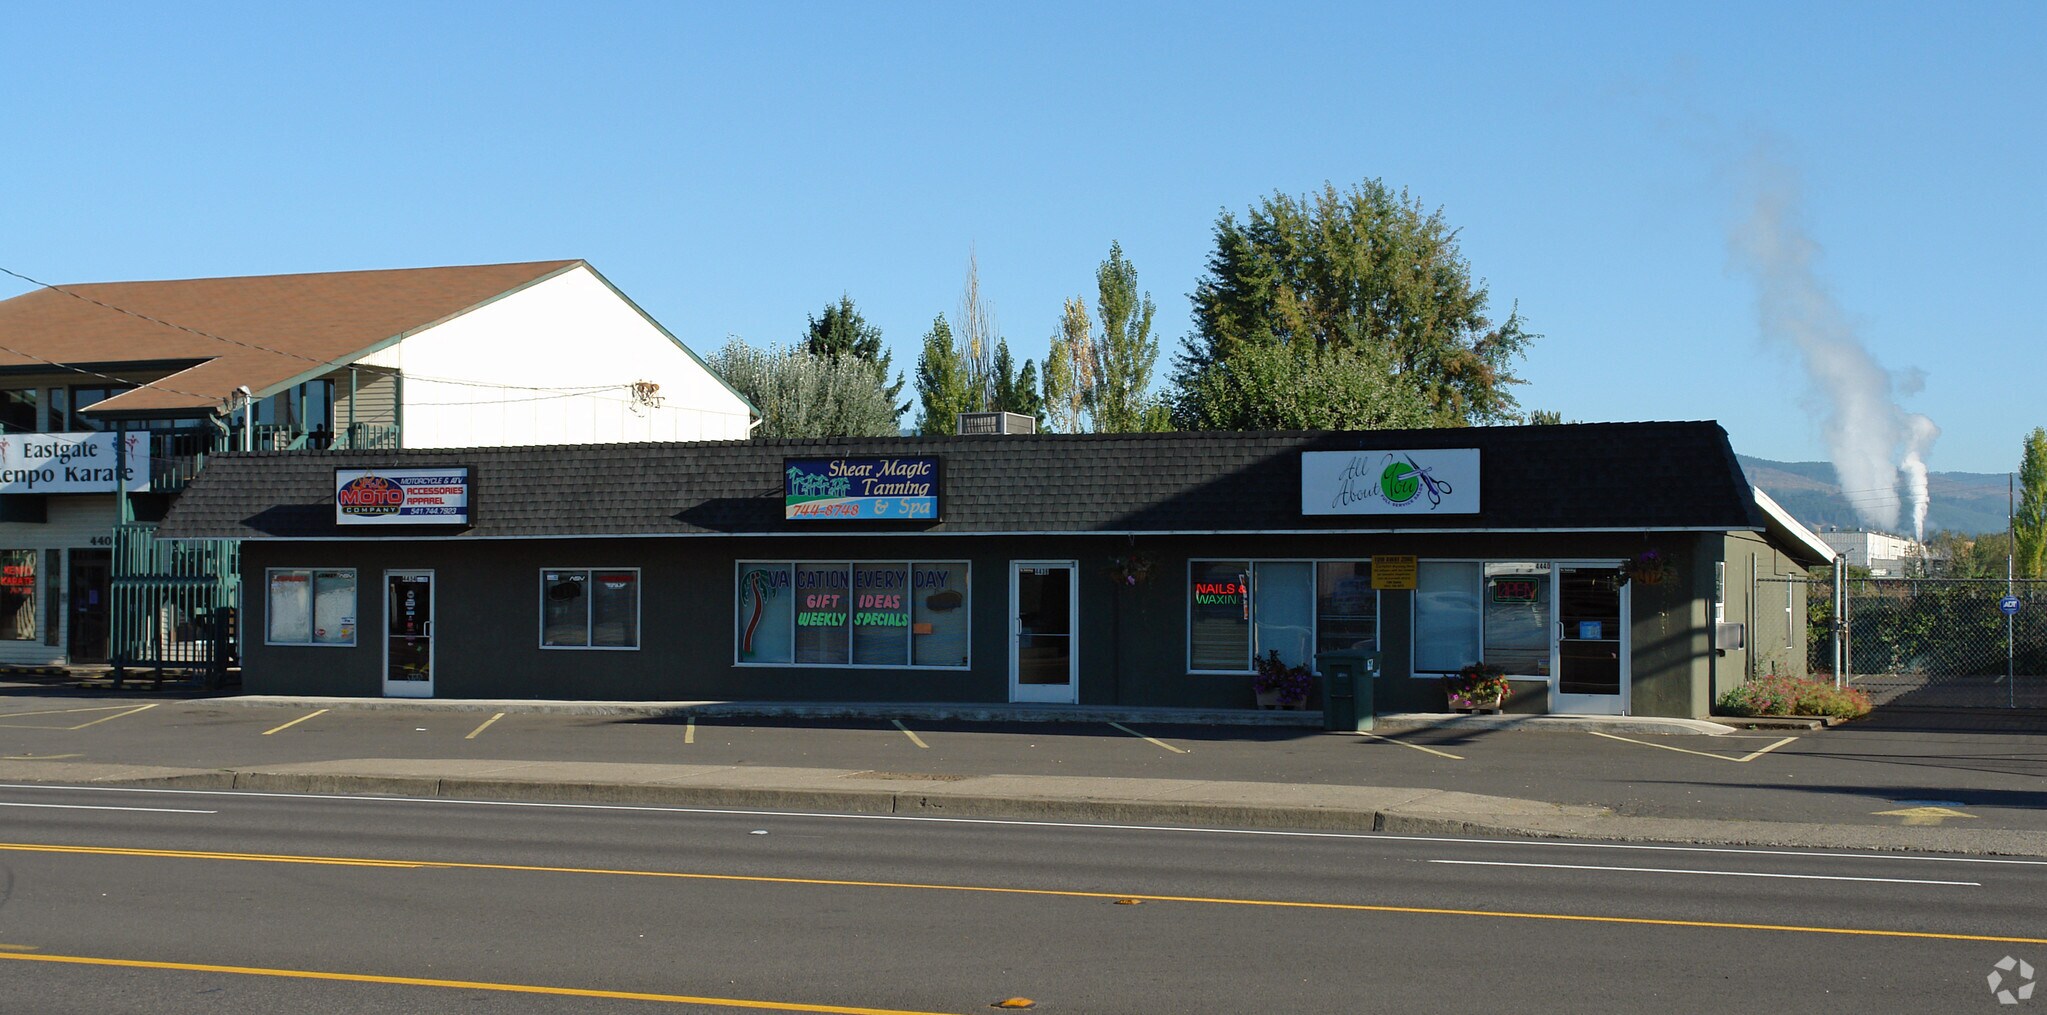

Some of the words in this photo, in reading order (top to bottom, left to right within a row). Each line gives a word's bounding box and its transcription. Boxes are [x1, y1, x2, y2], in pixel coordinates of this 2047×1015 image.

[24, 442, 98, 464] Eastgate
[828, 459, 873, 477] Shear
[876, 459, 932, 479] Magic
[1338, 456, 1370, 481] All
[1380, 453, 1414, 497] You
[406, 487, 464, 495] ACCESSORIES
[862, 478, 931, 497] Tanning
[1332, 479, 1381, 509] About
[341, 489, 403, 505] MOTO
[406, 497, 445, 505] APPAREL
[1392, 499, 1414, 507] SERVICE
[793, 504, 860, 516] 744-8748
[874, 499, 889, 515] &
[899, 498, 931, 519] Spa
[1, 576, 35, 586] KARATE
[856, 569, 907, 590] EVERY
[915, 569, 949, 589] DAY
[1196, 583, 1235, 595] NAILS
[1497, 582, 1535, 599] OPEN
[807, 594, 840, 609] GIFT
[858, 594, 901, 609] IDEAS
[798, 612, 847, 627] WEEKLY
[854, 612, 909, 627] SPECIALS
